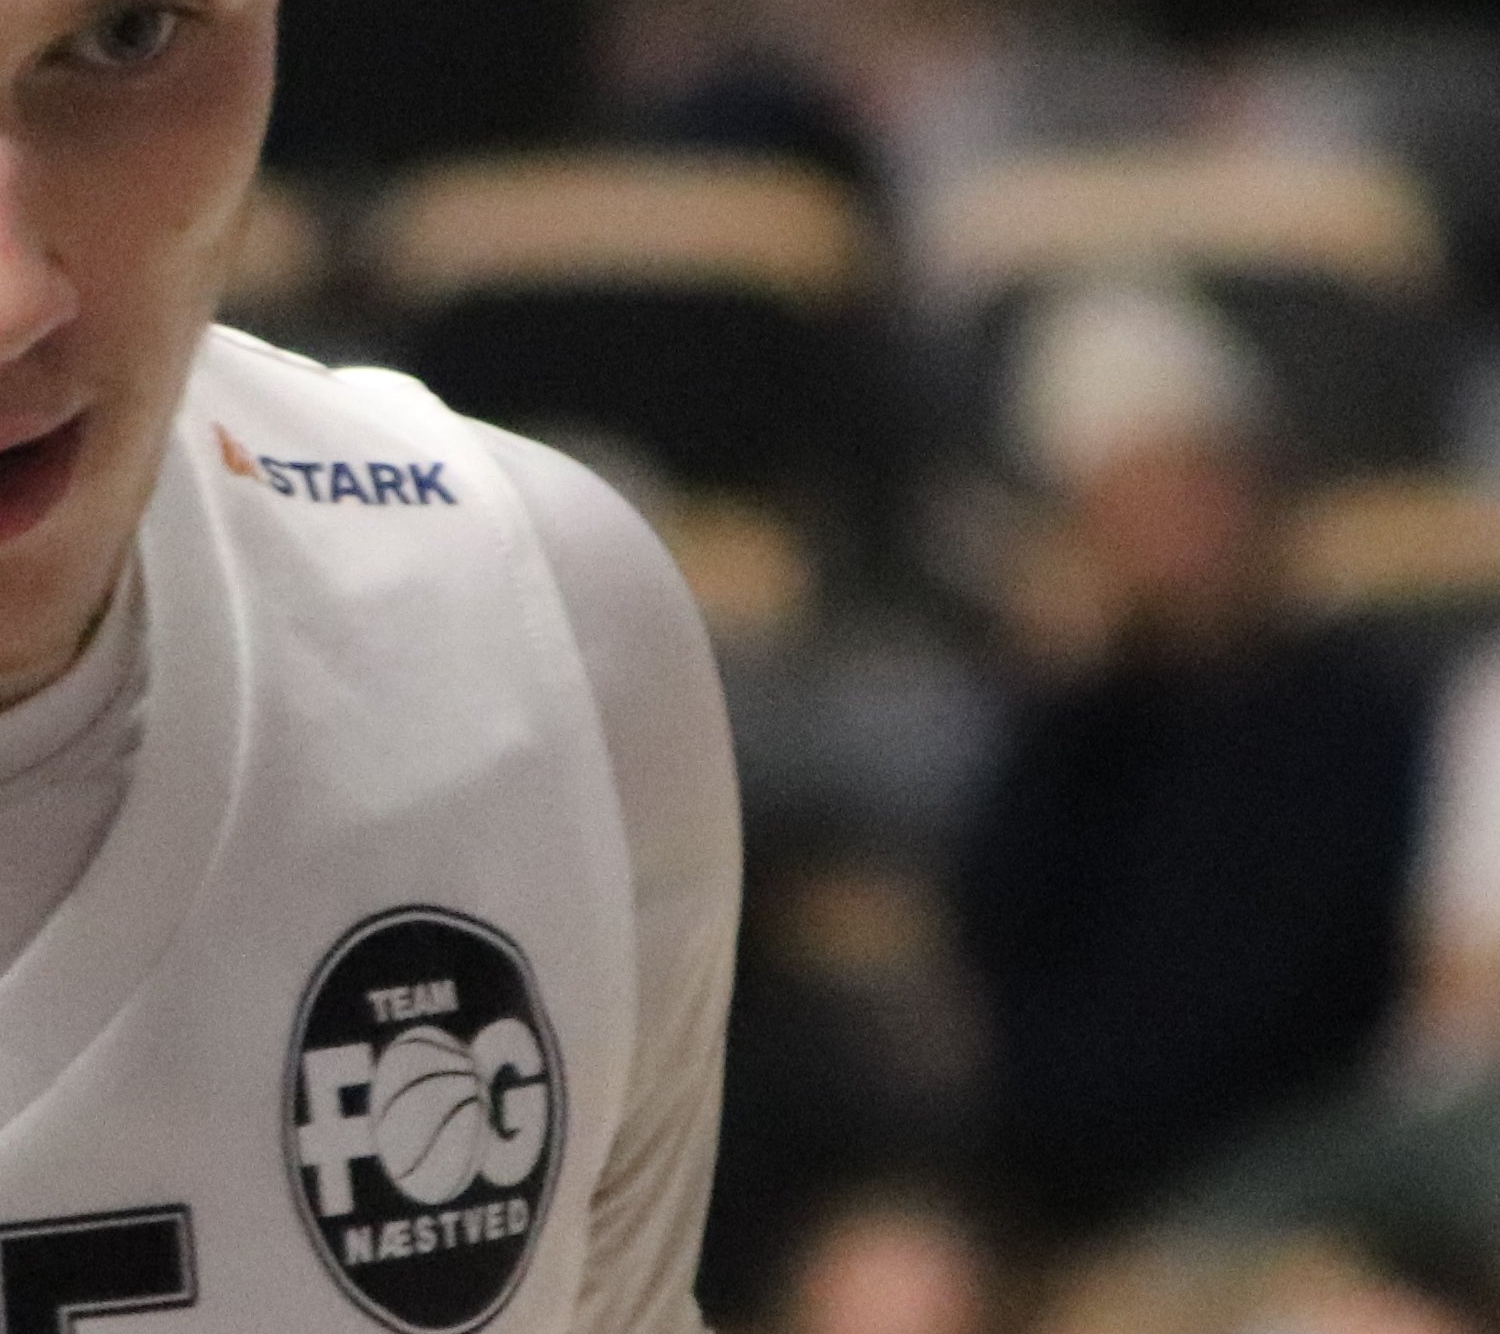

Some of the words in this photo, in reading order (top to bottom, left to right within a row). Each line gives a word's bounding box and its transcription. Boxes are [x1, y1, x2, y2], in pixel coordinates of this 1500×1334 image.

[257, 455, 458, 506] STARK
[368, 979, 459, 1023] TEAM
[343, 1198, 530, 1266] NÆSTVED
